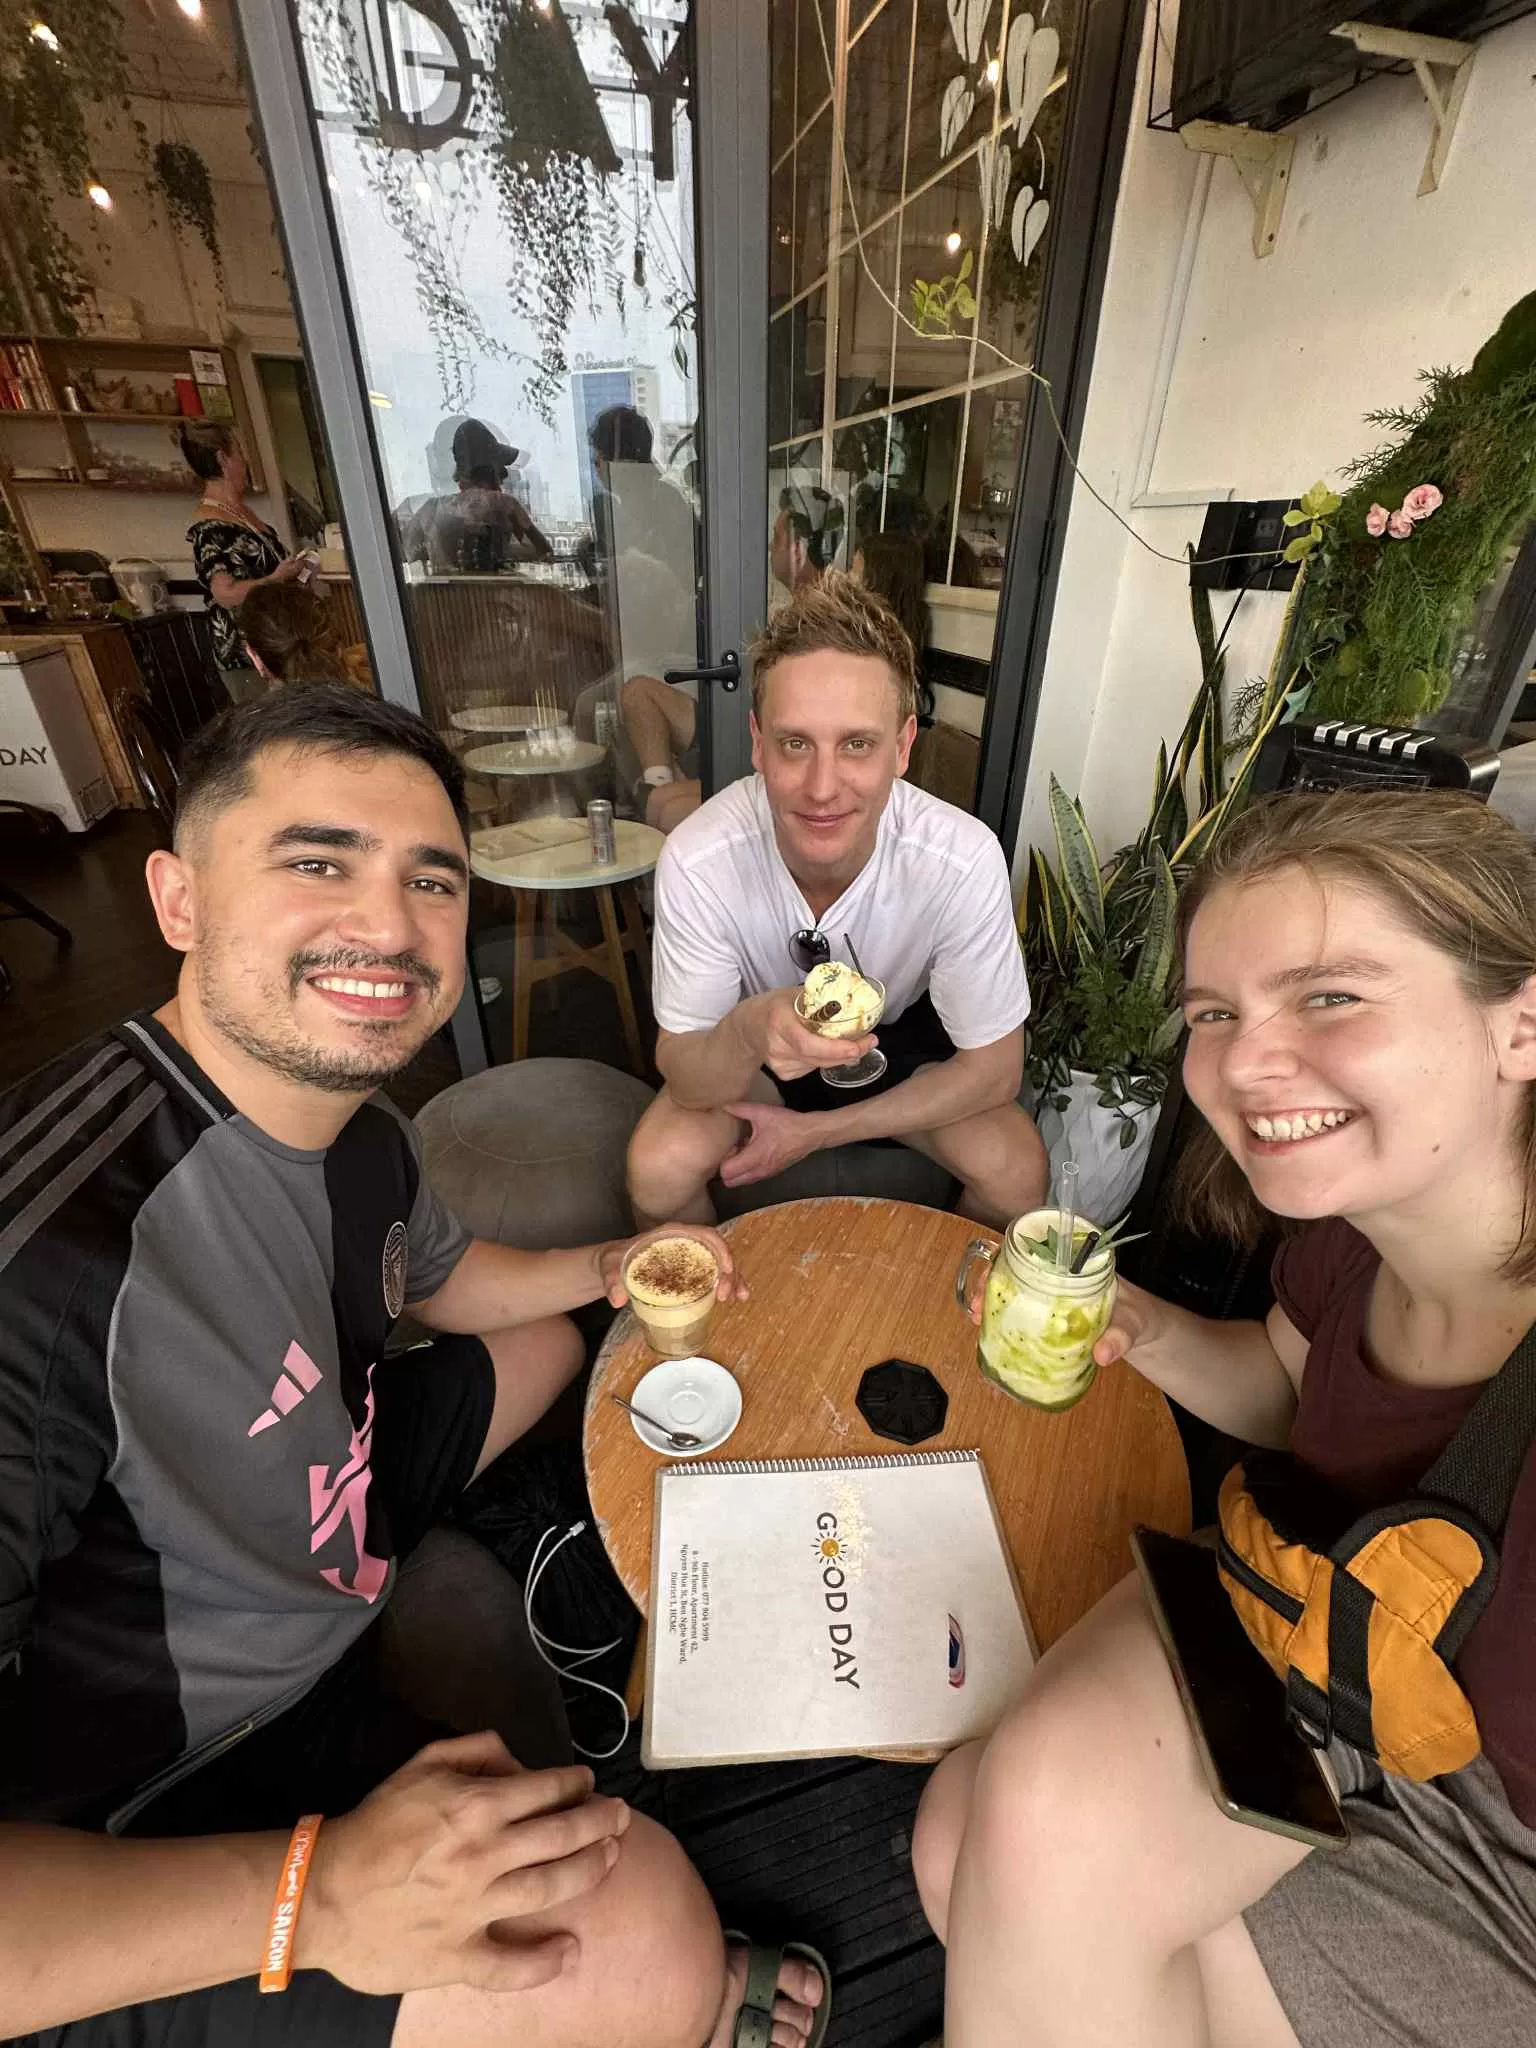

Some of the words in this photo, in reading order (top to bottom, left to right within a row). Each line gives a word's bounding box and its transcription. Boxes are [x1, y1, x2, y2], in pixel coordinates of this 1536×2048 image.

[0, 747, 47, 766] DAY
[680, 1544, 688, 1571] Nguyen
[679, 1617, 688, 1638] Nghe
[690, 1598, 699, 1639] Apartment
[829, 1623, 860, 1690] DAY
[266, 1901, 294, 1972] SAIGON
